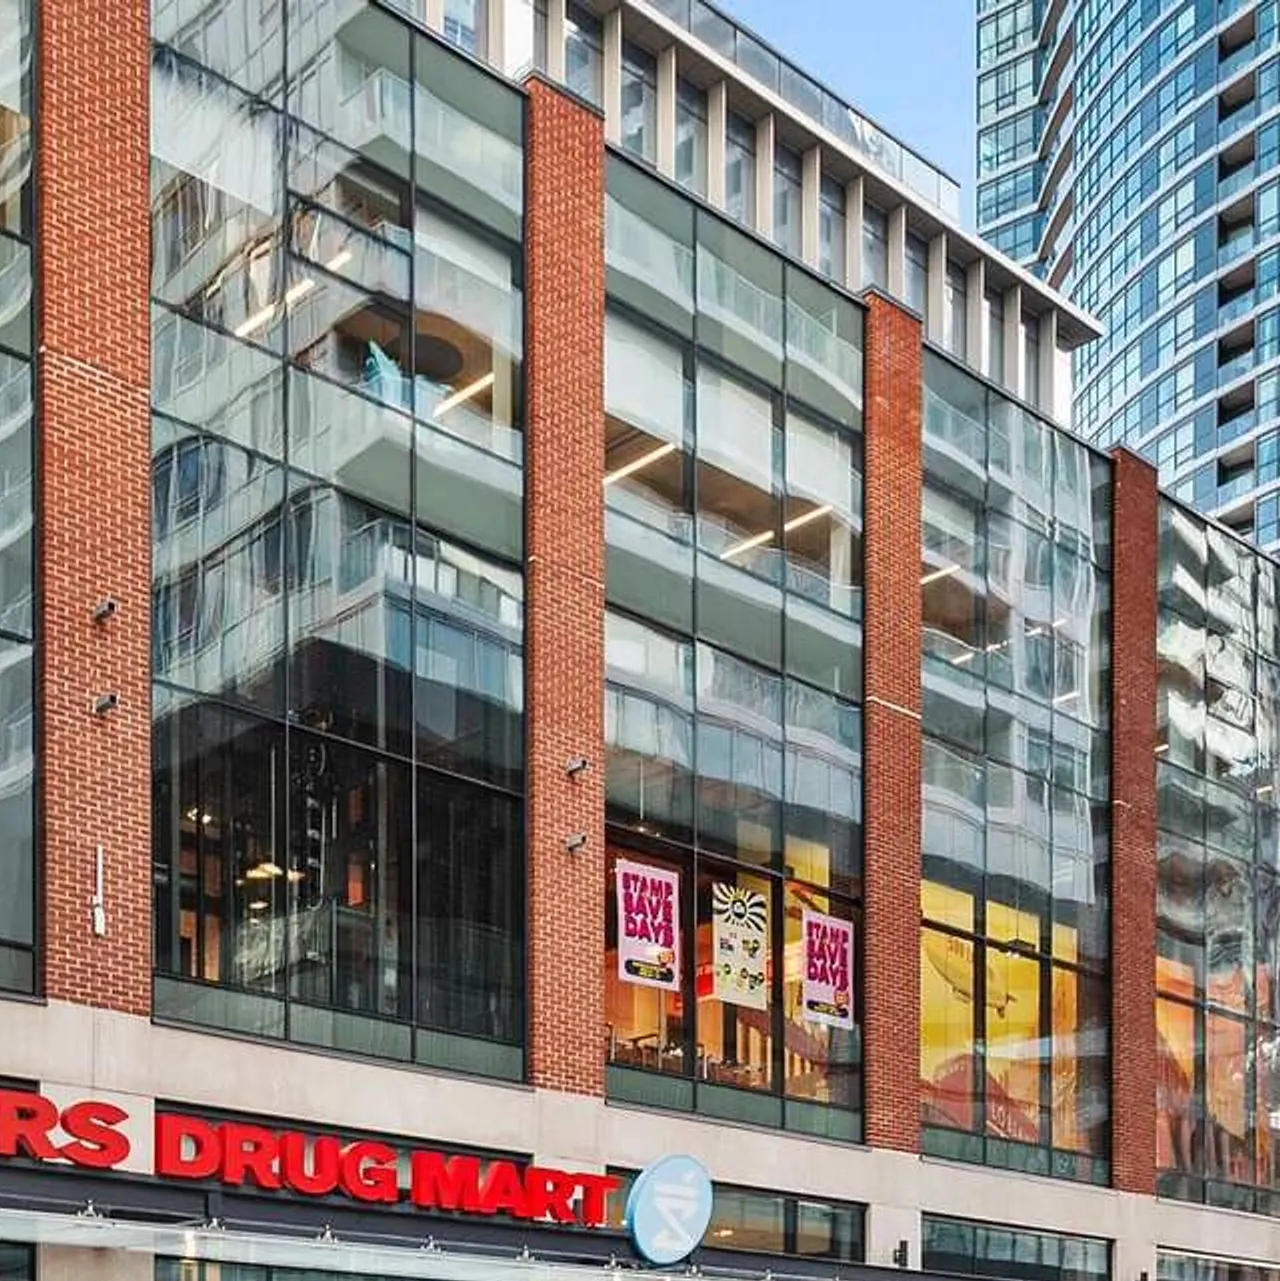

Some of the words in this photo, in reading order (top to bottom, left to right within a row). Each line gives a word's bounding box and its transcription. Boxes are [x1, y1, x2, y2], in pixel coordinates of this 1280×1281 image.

[624, 914, 674, 948] DAYS
[155, 1111, 399, 1202] DRUG
[411, 1148, 618, 1228] MART
